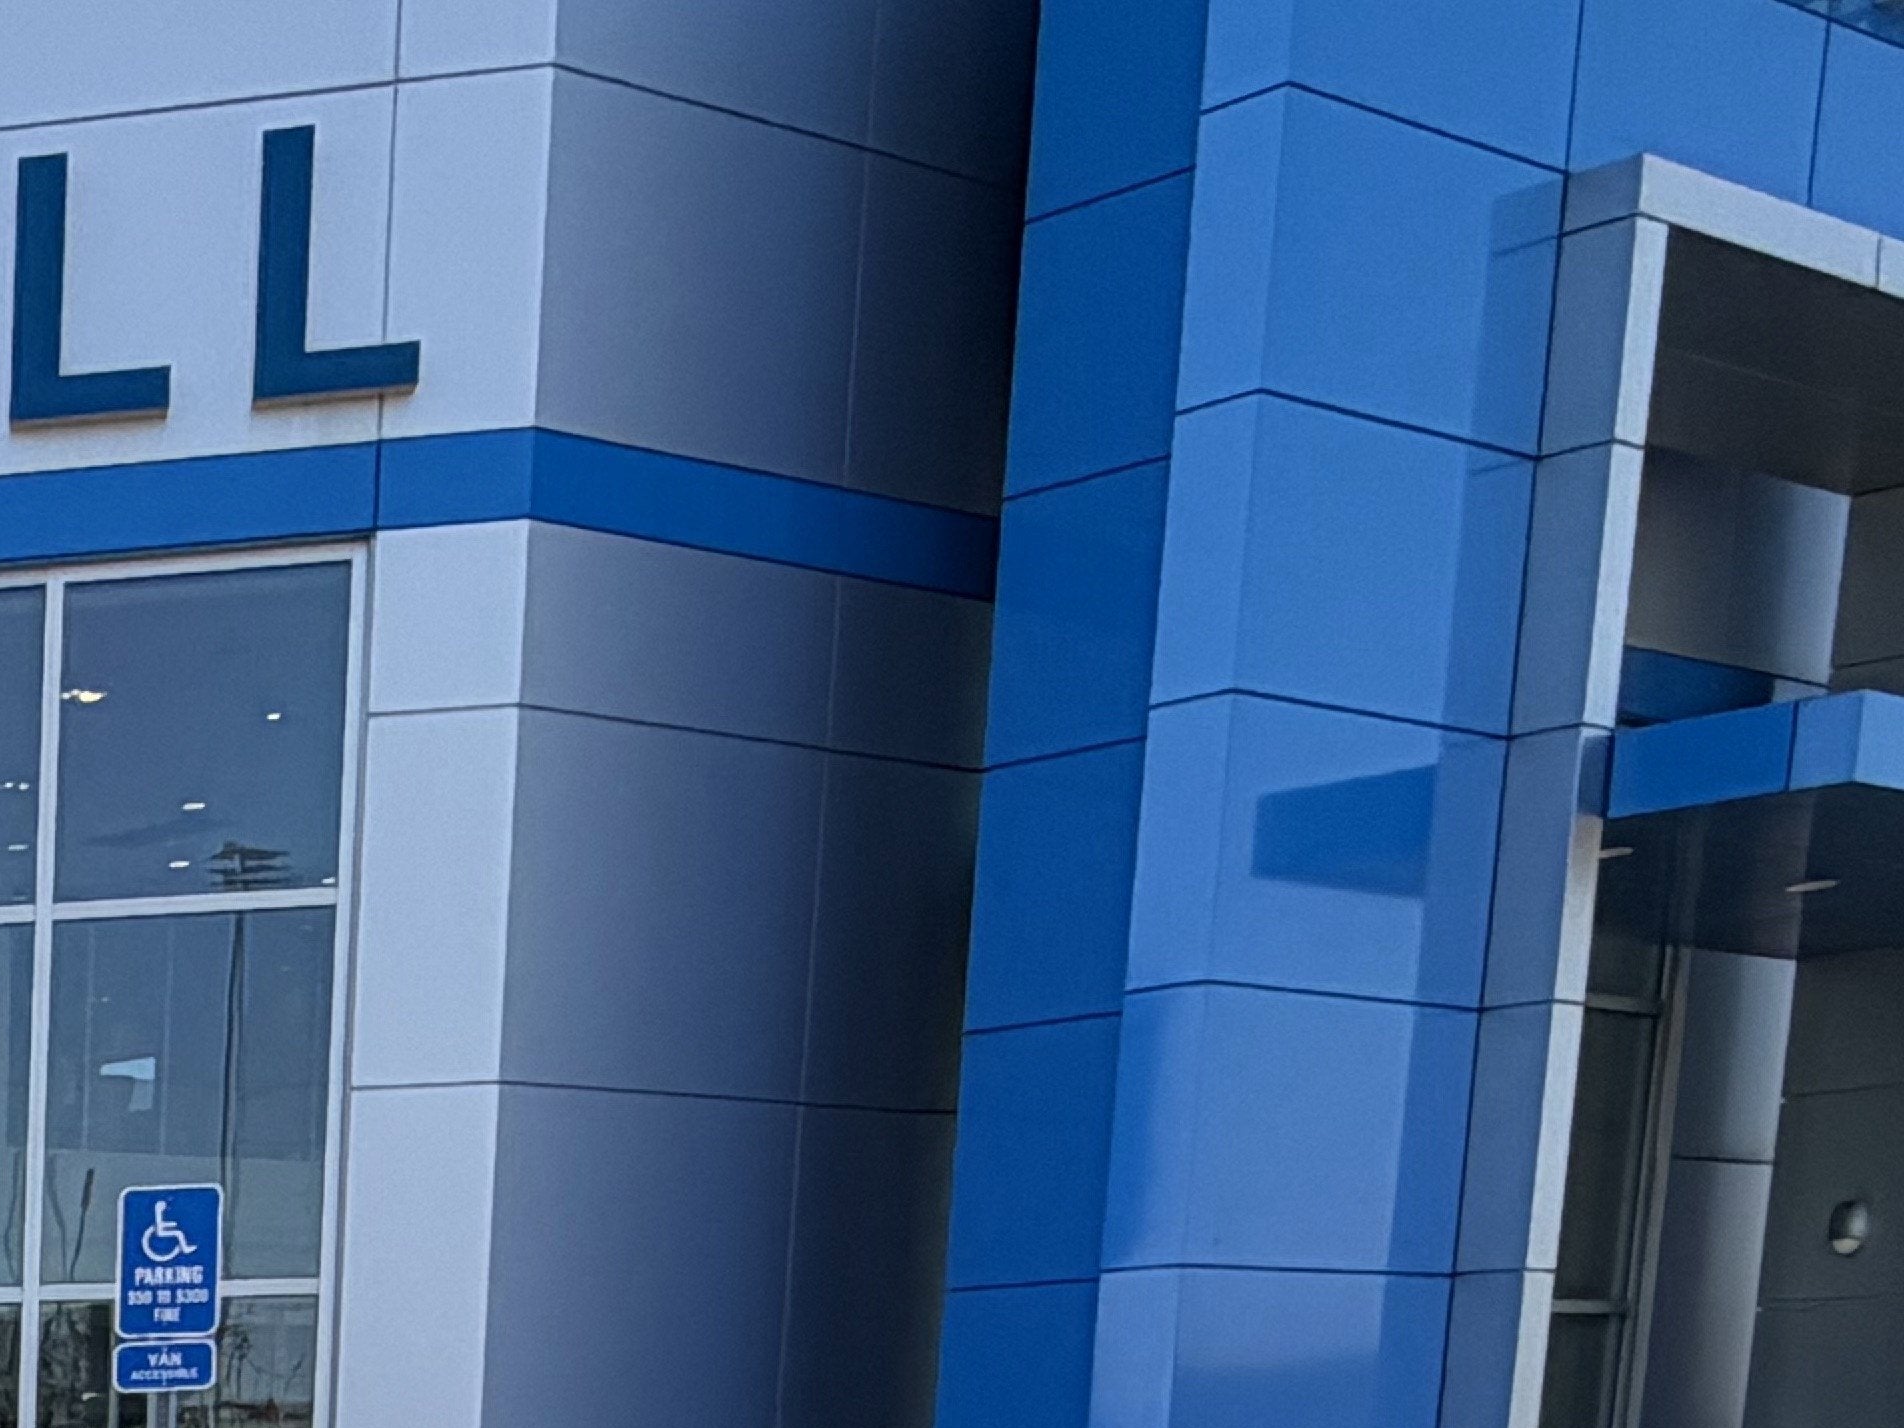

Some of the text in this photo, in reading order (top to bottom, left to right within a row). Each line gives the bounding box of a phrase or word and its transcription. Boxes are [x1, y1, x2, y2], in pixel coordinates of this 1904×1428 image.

[135, 1265, 203, 1285] PARKING
[153, 1307, 181, 1322] FINE
[148, 1351, 182, 1367] VAN
